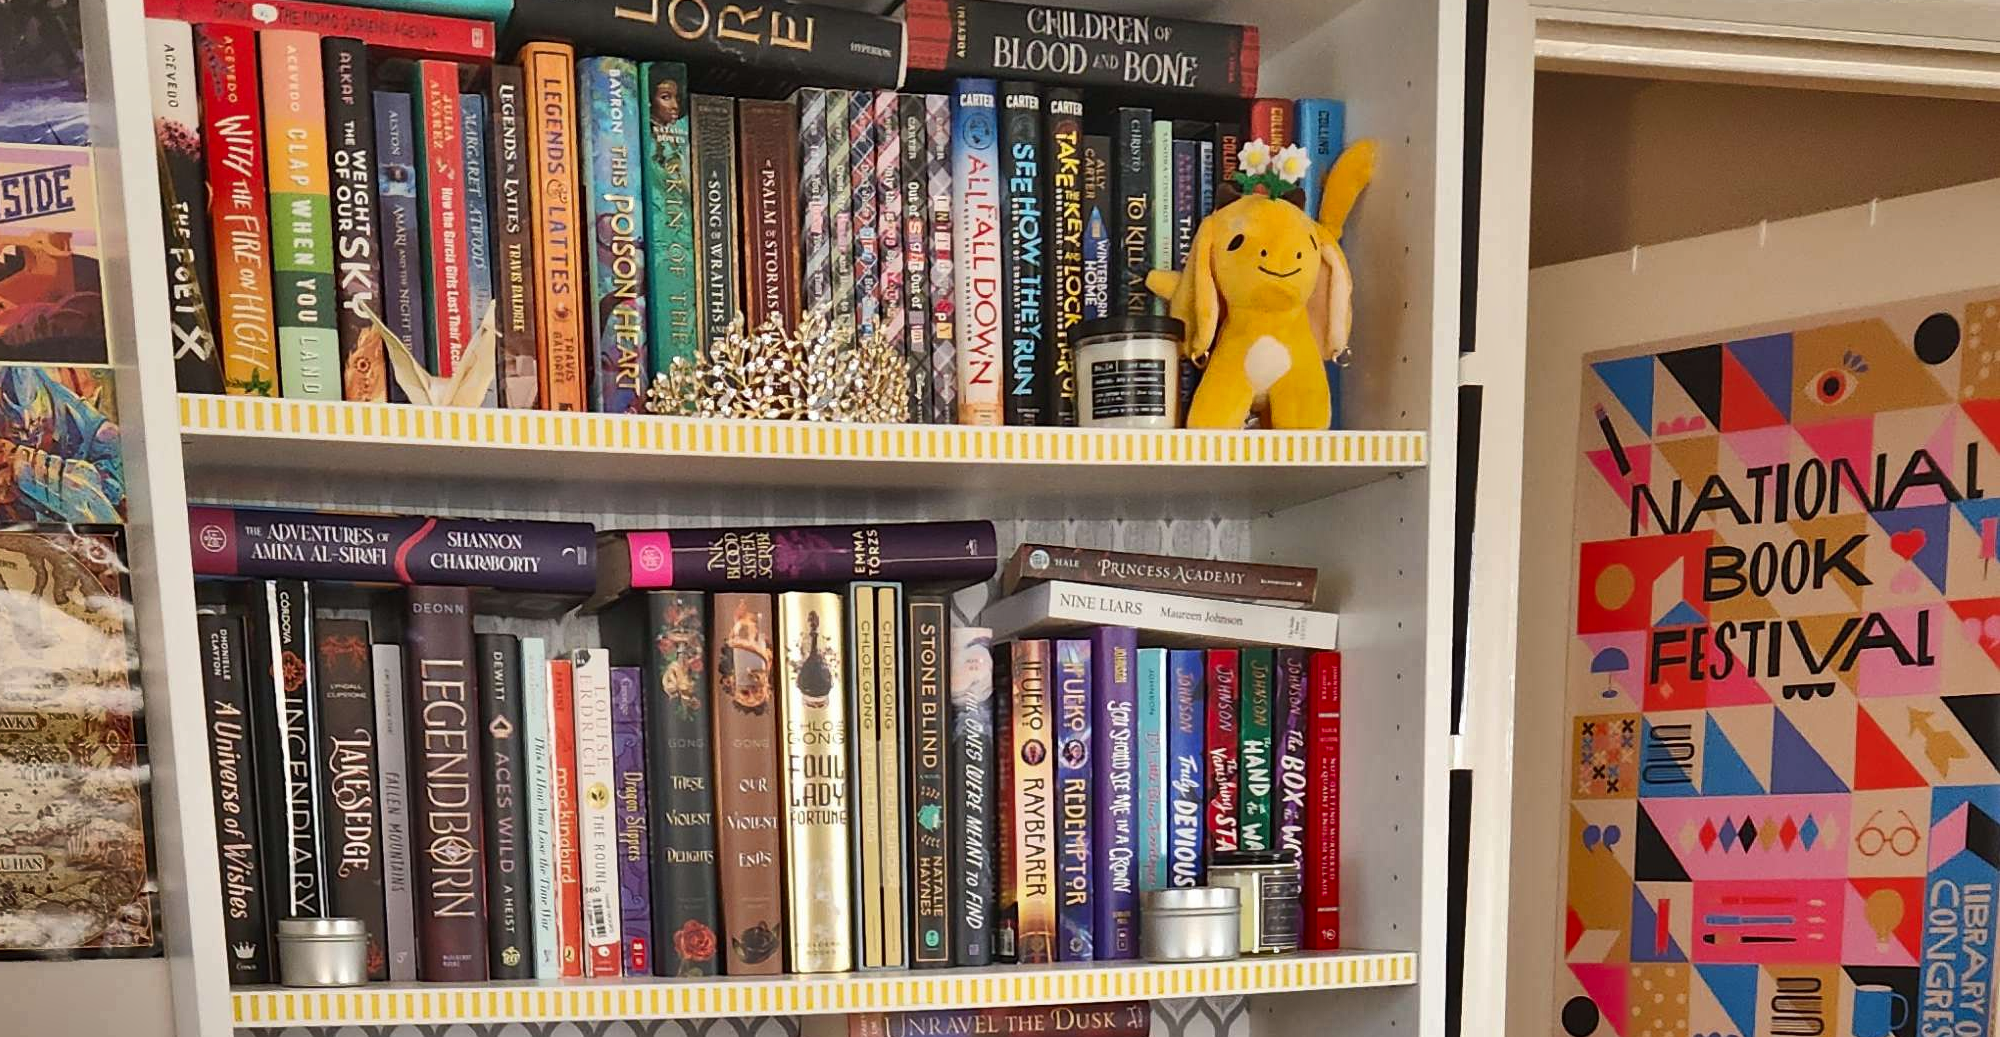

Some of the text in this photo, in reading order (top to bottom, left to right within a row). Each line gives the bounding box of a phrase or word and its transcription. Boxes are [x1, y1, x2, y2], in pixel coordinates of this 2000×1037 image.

[613, 0, 815, 51] LORE
[955, 5, 967, 57] ADEYEMI
[1027, 5, 1173, 45] CHILDREN OF
[164, 44, 180, 108] ACEVEDO
[222, 35, 239, 104] ACEVEDO
[994, 37, 1087, 75] BLOOD
[1091, 51, 1119, 70] AND
[1124, 49, 1199, 87] BONE
[388, 110, 401, 157] ALSTON
[429, 79, 456, 150] JULIA ALVAREZ
[1270, 106, 1284, 153] COLLINS
[1318, 109, 1330, 155] COLLINS
[214, 115, 255, 178] WITH
[1129, 119, 1143, 173] CHRISTO
[0, 168, 76, 220] SIDE
[230, 180, 254, 210] THE
[334, 52, 373, 319] ALKAF THE WEIGHT OF OUR SKY
[543, 78, 570, 295] LEGENDS & LATTES
[1084, 147, 1106, 199] ALLY CARTER
[286, 45, 323, 396] ACEVEDO CLAP WHEN YOU LAND
[1127, 192, 1148, 220] TO
[223, 215, 263, 269] FIRE
[604, 68, 642, 397] BAYRON THIS POISON HEART
[959, 93, 998, 385] CARTER ALL FALL DOWN
[1006, 94, 1043, 396] CARTER SEE HOW THEY RUN
[1125, 225, 1148, 269] KILL
[169, 201, 214, 362] THE POET X
[441, 187, 462, 341] How the Garcia Girls Lost Their
[1128, 271, 1144, 286] A
[227, 293, 271, 371] HIGH
[552, 331, 576, 384] TRAVIS BALDREE
[1630, 441, 1985, 537] NATIONAL
[245, 525, 262, 537] THE
[267, 523, 374, 547] ADVENTURES
[251, 542, 387, 566] AMINA AL-SIRAFI
[447, 531, 523, 551] SHANNON
[706, 540, 726, 573] INK
[725, 531, 742, 580] BLOOD
[741, 532, 758, 579] SISTER
[755, 531, 775, 580] SCRIBE
[853, 529, 866, 575] EMMA
[867, 528, 882, 576] TÖRZS
[430, 552, 542, 574] CHAKRABORTY
[1053, 557, 1080, 569] HALE
[1098, 558, 1172, 580] PRINCESS
[1172, 565, 1247, 585] ACADEMY
[1703, 534, 1874, 603] BOOK
[411, 602, 465, 615] DEONN
[1059, 592, 1244, 627] NINE LIARS Maureen Johnson
[211, 629, 232, 681] DHONIELLE CLAYTON
[860, 620, 873, 677] CHLOE
[881, 620, 893, 677] CHLOE
[920, 623, 937, 697] STONE
[1649, 608, 1936, 686] FESTIVAL
[862, 680, 874, 730] GONG
[882, 680, 893, 730] GONG
[1148, 667, 1156, 717] JOHNSON
[579, 674, 597, 777] ERDRICH
[594, 686, 610, 767] LOUISE
[667, 738, 704, 749] GONG
[732, 738, 770, 749] GONG
[787, 720, 845, 732] CHLOE
[787, 732, 845, 746] GONG
[921, 702, 939, 768] BLIND
[419, 658, 478, 919] LEGENDBORN
[492, 651, 516, 934] DEWITT ACES WILD A HEIST
[670, 774, 706, 792] THESE
[738, 777, 769, 793] OUR
[788, 754, 845, 780] FOUL
[1020, 661, 1048, 899] IFUEKO RAYBEARER
[1062, 663, 1088, 907] IFUEKO REDEMPTOR
[1171, 667, 1200, 887] JOHNSON Truly DEVIOUS
[213, 699, 255, 919] A Universe of Wishes
[329, 728, 374, 879] LAKESEDGE
[665, 808, 711, 827] VIOLENT
[726, 811, 778, 831] VIOLENT
[789, 782, 845, 808] LADY
[789, 809, 848, 826] FORTUNE
[964, 692, 985, 930] THE ONES WERE MEANT TO FIND
[534, 737, 552, 931] This Is How You Lose the Time War
[556, 766, 578, 884] mockingbird
[593, 815, 605, 838] THE
[12, 857, 44, 871] HAN
[667, 846, 715, 865] DELIGHTS
[738, 849, 773, 868] ENDS
[1329, 827, 1337, 881] MURDERED
[919, 854, 944, 918] NATALIE HAYNES
[1922, 878, 1960, 1037] CONGRES
[1960, 881, 1993, 1015] LIBRARY
[885, 1014, 999, 1037] UNRAVEL
[1005, 1014, 1045, 1033] THE
[1050, 1007, 1117, 1031] DUSK
